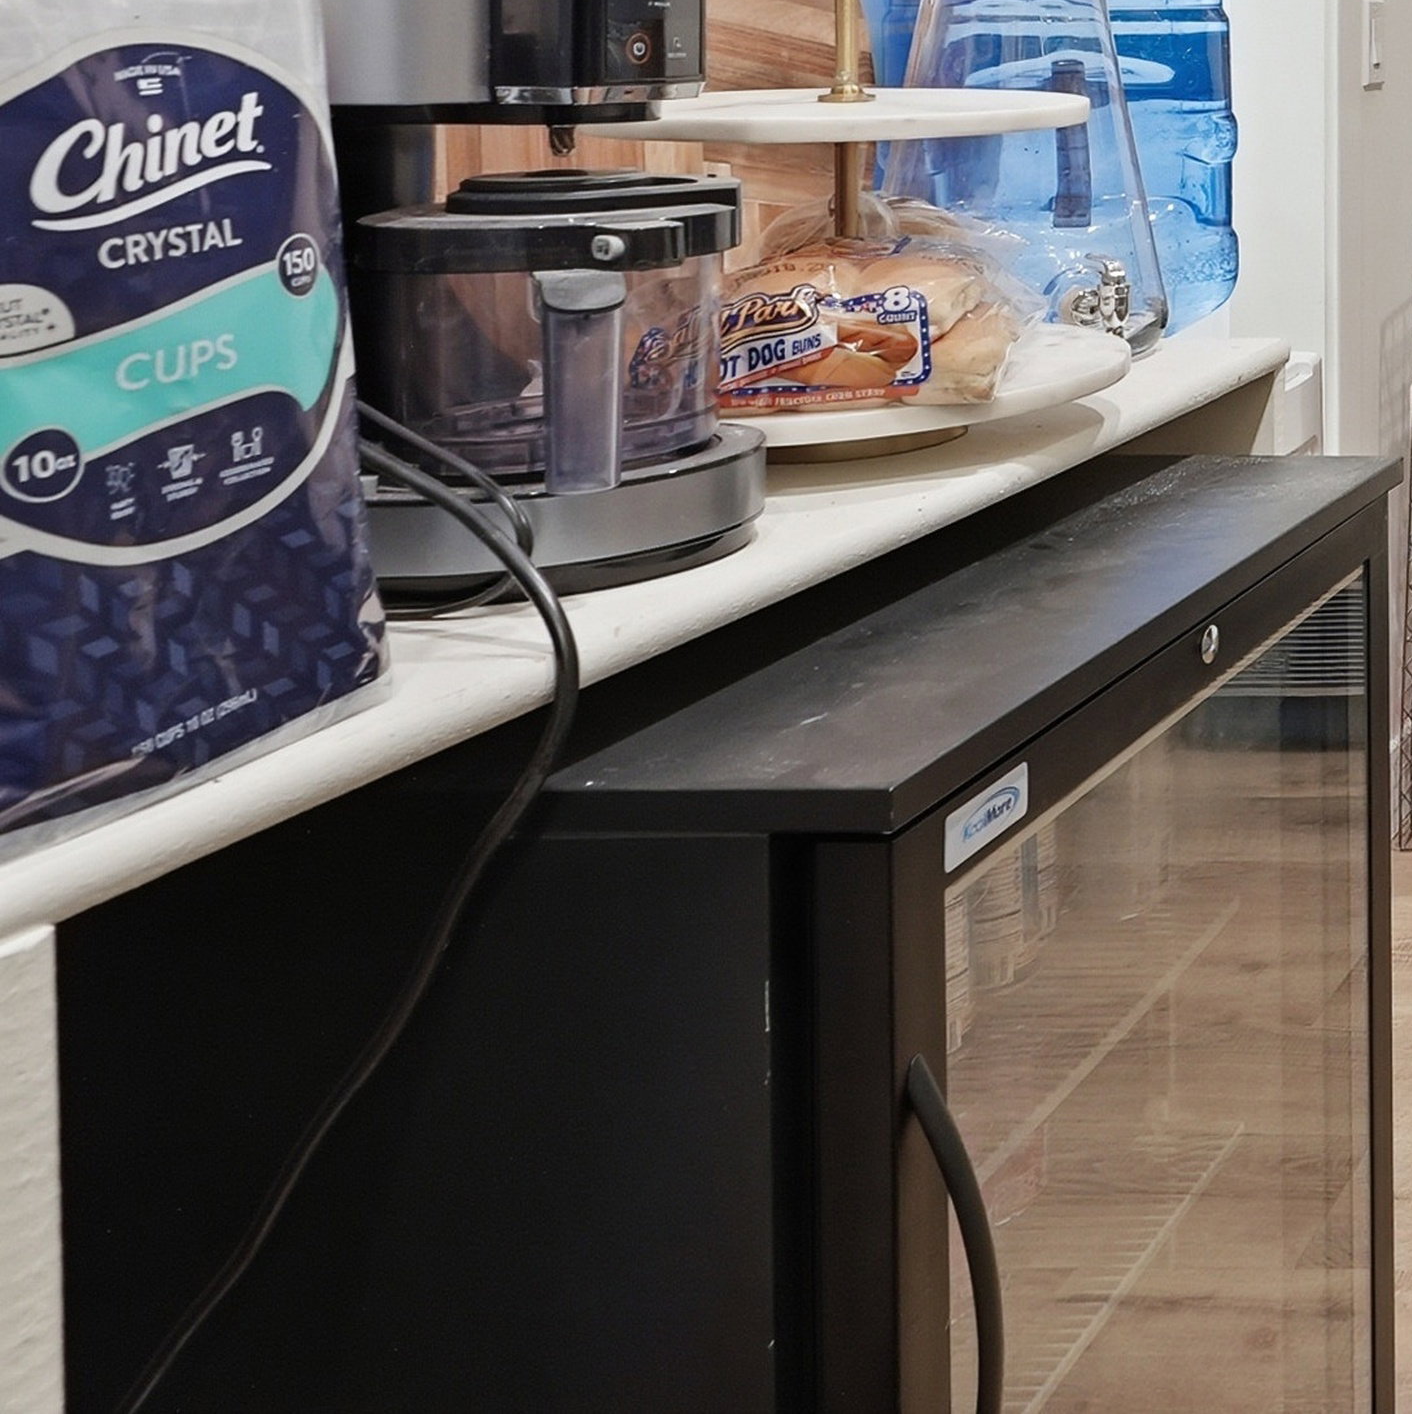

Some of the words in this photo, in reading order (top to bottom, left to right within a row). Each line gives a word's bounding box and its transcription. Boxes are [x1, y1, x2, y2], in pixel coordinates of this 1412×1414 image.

[29, 91, 264, 215] Chinet
[99, 217, 244, 270] CRYSTAL
[282, 246, 316, 276] 150
[878, 310, 917, 324] COUNT
[883, 286, 912, 312] 8
[115, 333, 238, 390] CUPS
[720, 355, 742, 382] OT
[748, 338, 786, 372] DOG
[792, 333, 822, 356] BUNS
[155, 722, 185, 749] CUPS
